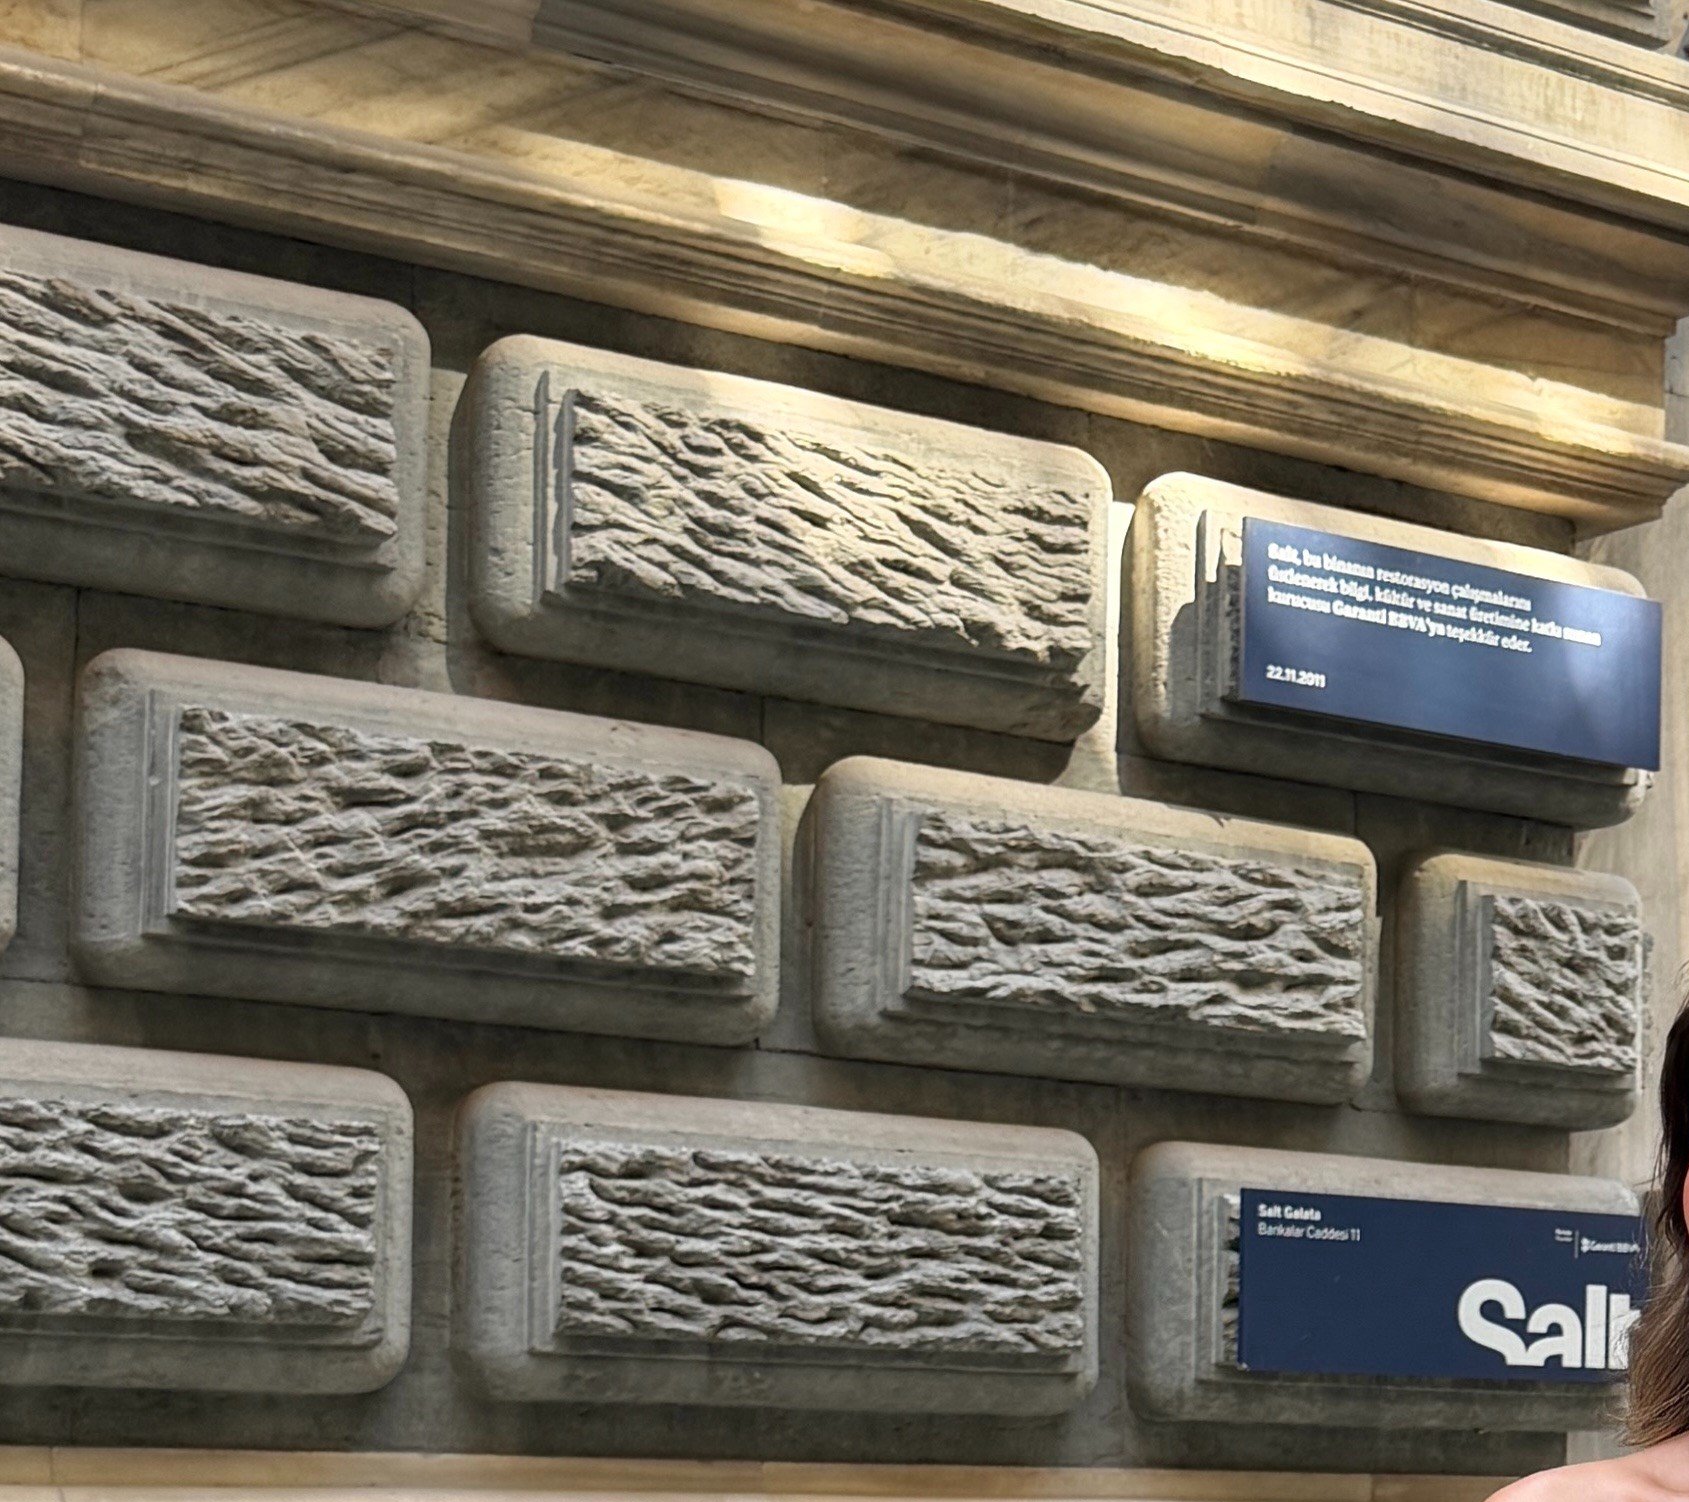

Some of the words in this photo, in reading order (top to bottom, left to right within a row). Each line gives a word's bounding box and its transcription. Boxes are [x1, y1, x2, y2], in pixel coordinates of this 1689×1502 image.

[1302, 549, 1322, 568] bu
[1376, 568, 1450, 595] restorasyon
[1332, 600, 1387, 625] Garanti
[1417, 598, 1432, 612] ve
[1433, 602, 1467, 619] sanat
[1266, 664, 1326, 688] 22.11.2011
[1258, 1203, 1282, 1218] Salt
[1284, 1204, 1322, 1221] Galata
